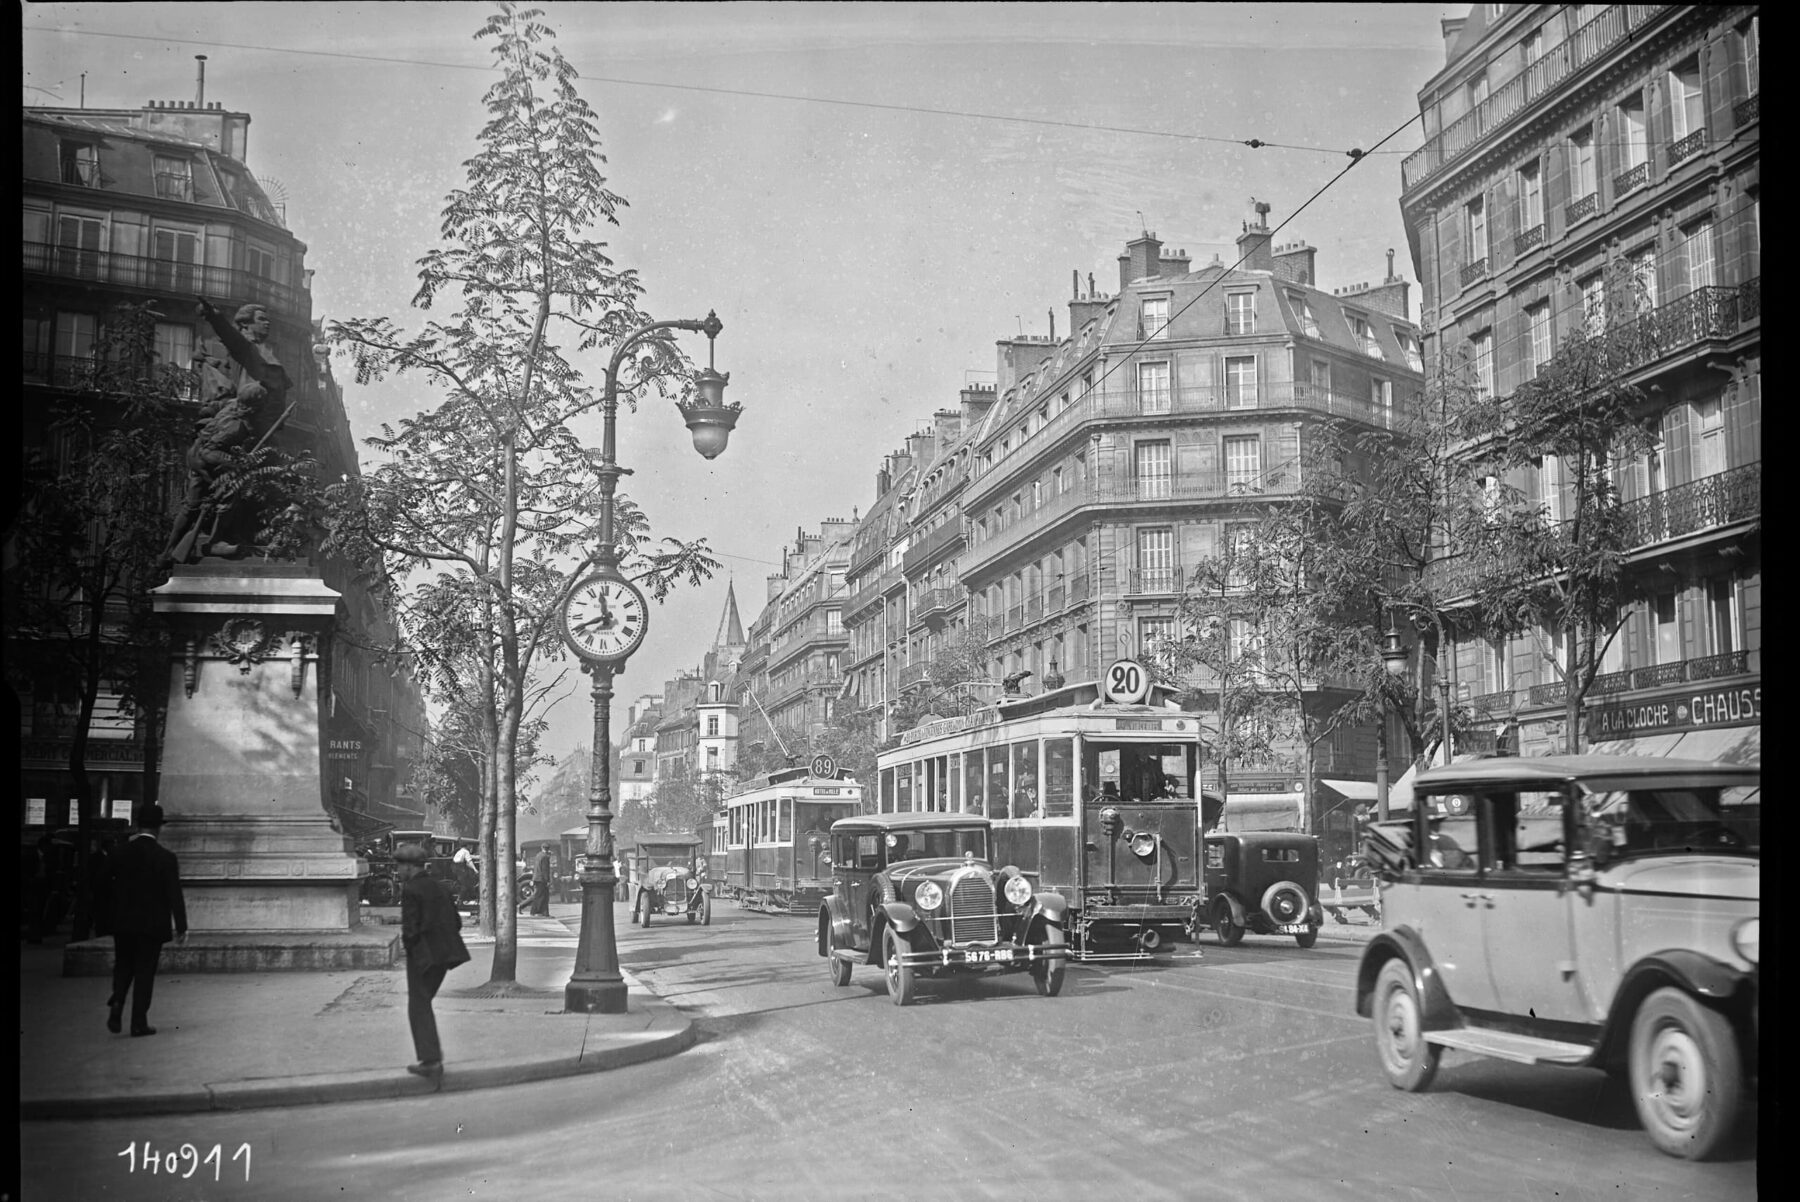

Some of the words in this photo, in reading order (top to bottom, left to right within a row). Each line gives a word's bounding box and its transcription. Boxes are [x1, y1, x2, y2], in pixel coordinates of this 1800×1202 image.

[1112, 666, 1140, 694] 20
[1602, 713, 1610, 731] A
[1611, 711, 1625, 731] LA
[815, 759, 832, 774] 89
